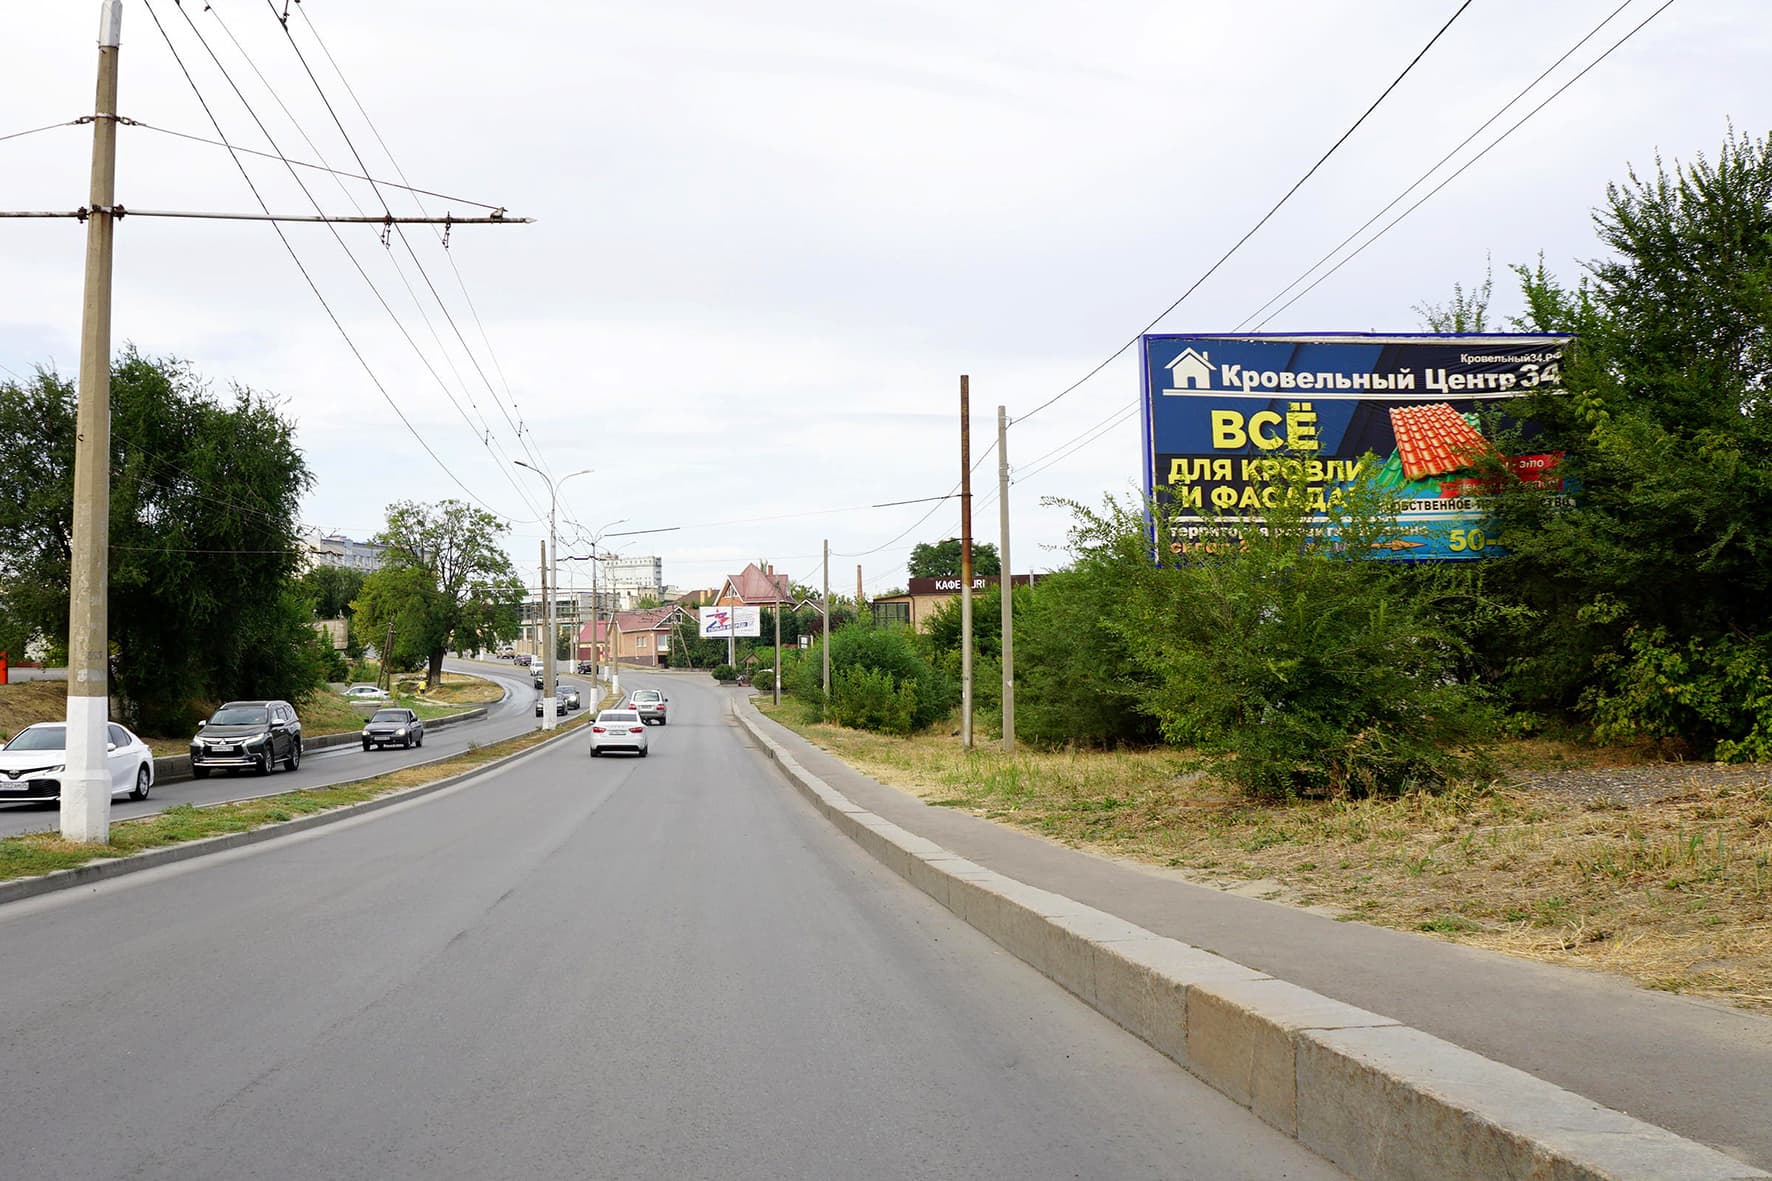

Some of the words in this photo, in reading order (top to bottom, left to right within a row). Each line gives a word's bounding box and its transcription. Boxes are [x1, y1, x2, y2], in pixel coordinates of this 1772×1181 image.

[1221, 364, 1415, 393] Кровельный
[1425, 368, 1517, 393] Центр
[1519, 363, 1562, 388] 34
[1211, 402, 1319, 450] ВСЁ
[1168, 458, 1233, 484] ДЛЯ
[1241, 459, 1364, 482] КРОВЛИ
[1182, 486, 1203, 508] И
[1382, 499, 1471, 512] ОБСТВЕННОЕ
[935, 580, 961, 590] КАФЕ
